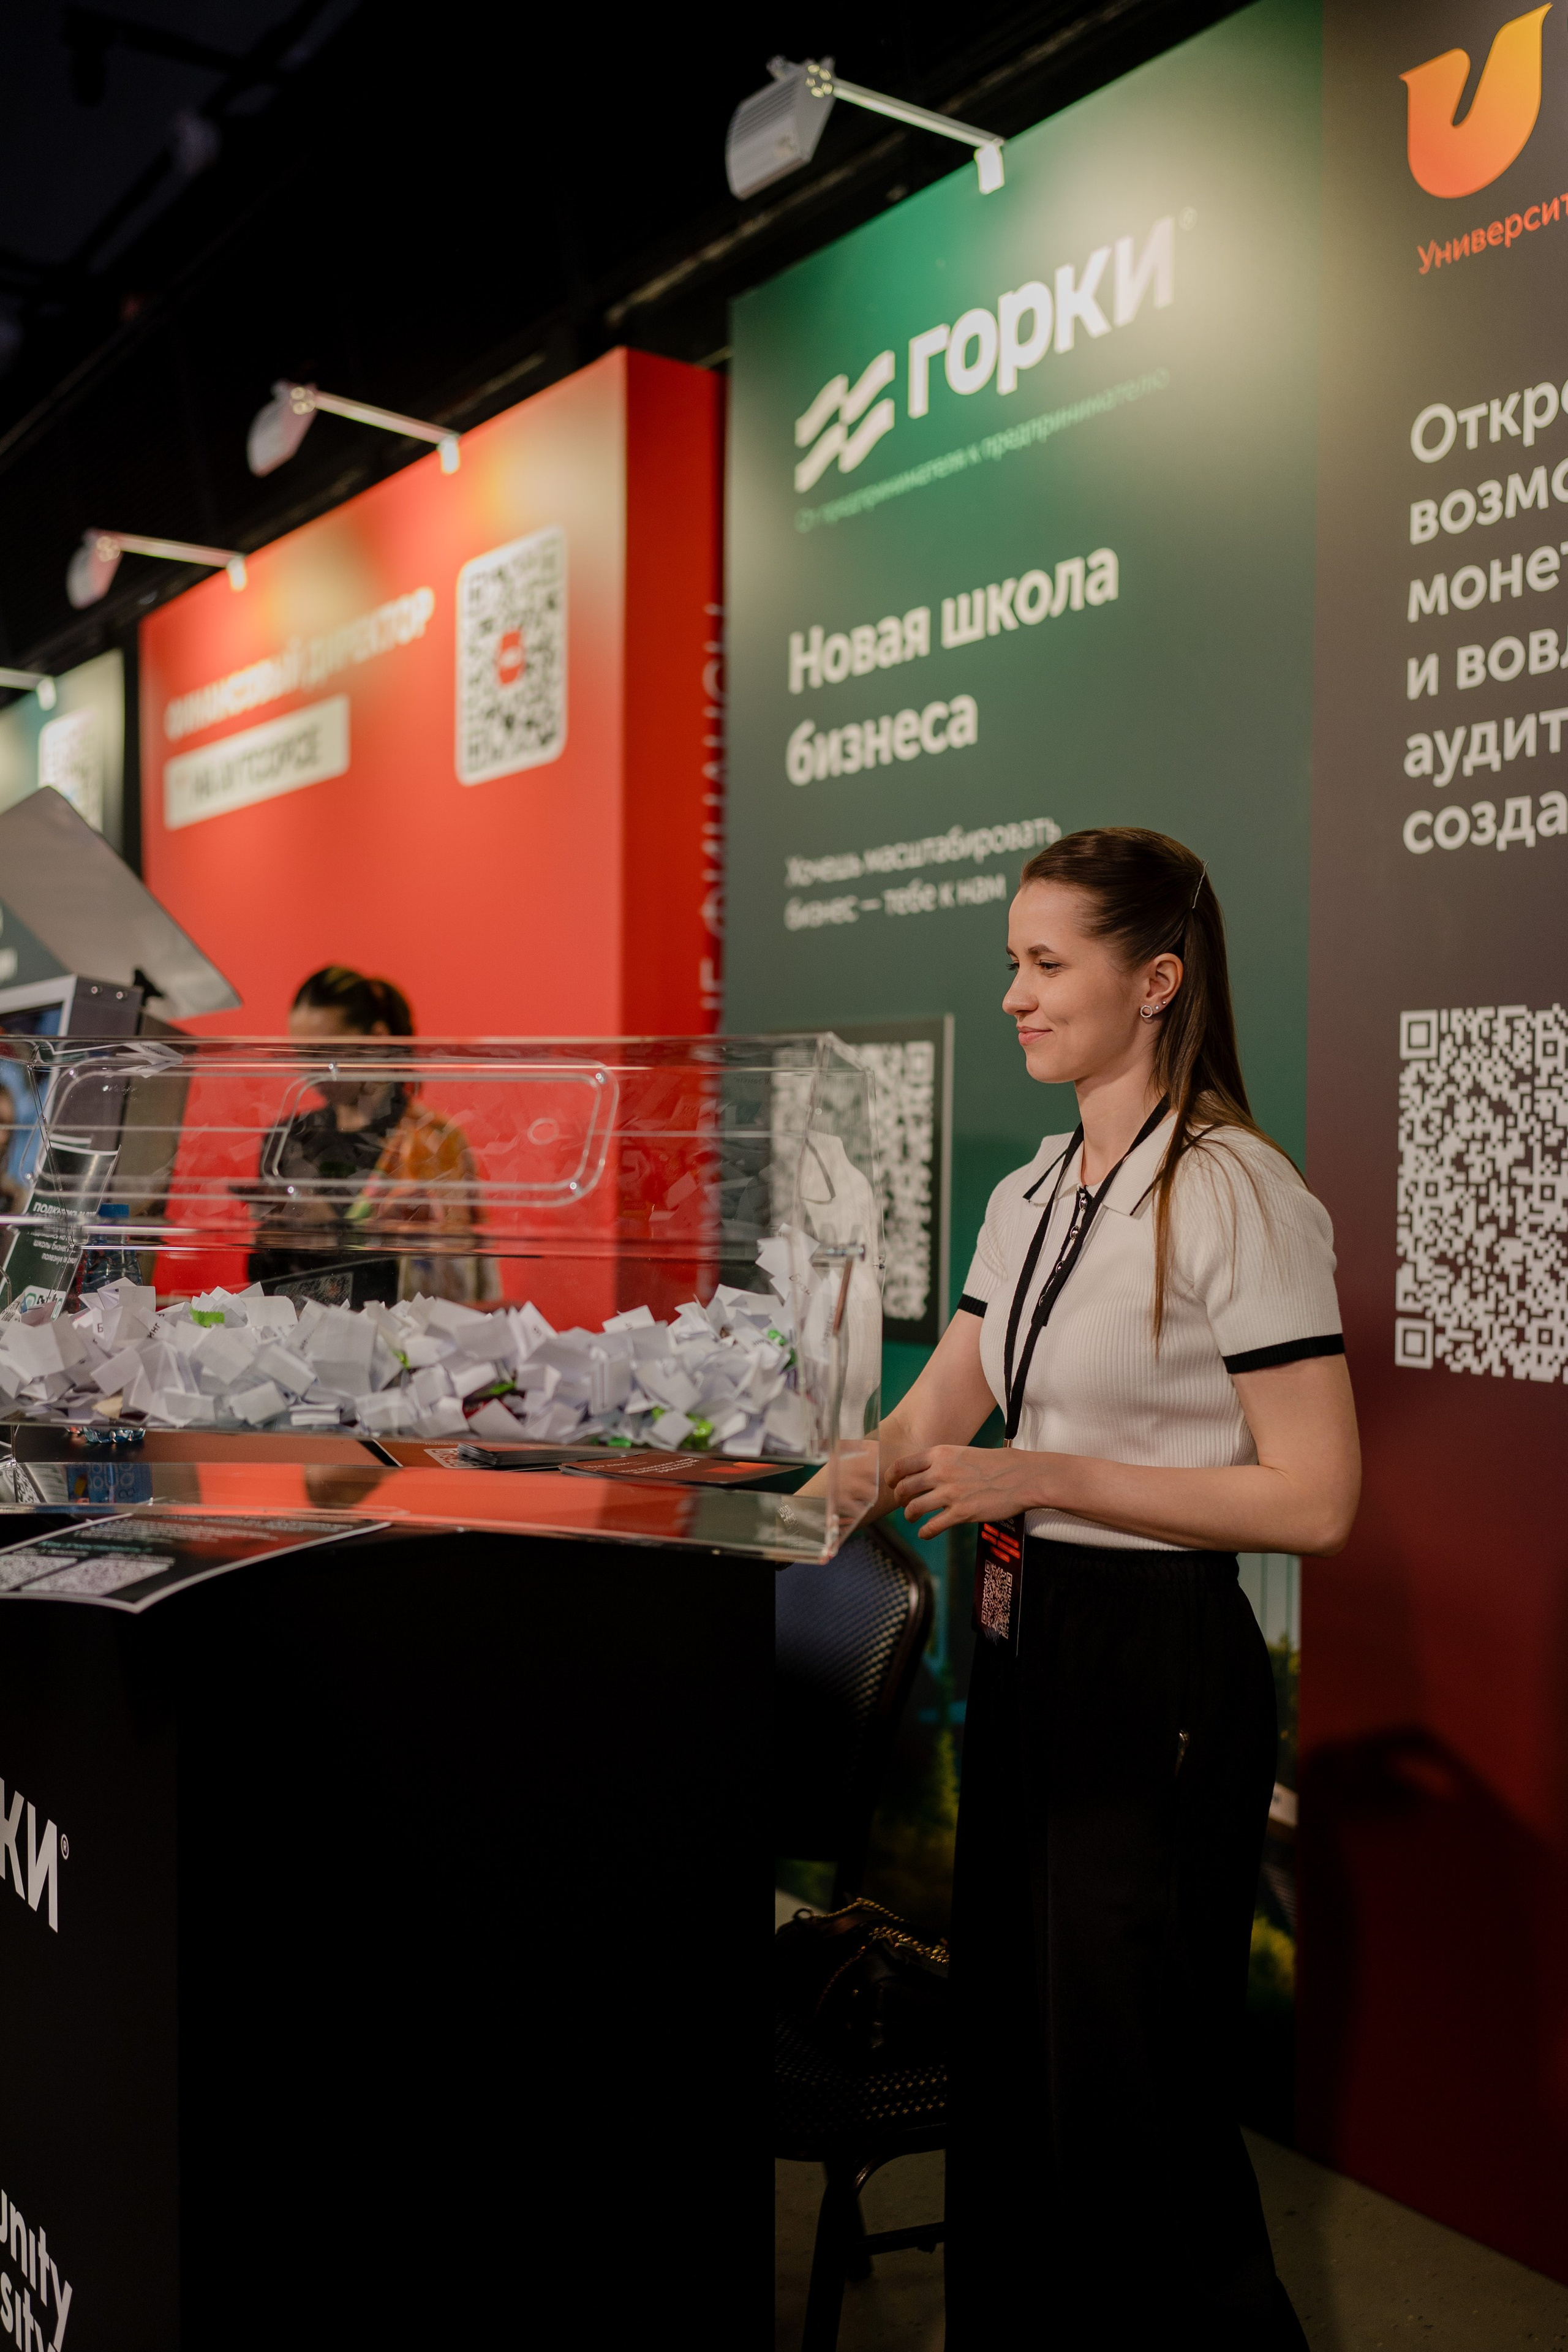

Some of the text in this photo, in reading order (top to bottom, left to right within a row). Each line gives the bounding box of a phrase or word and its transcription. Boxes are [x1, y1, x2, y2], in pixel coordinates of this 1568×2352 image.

[1410, 379, 1568, 464] Откр
[788, 547, 1120, 694] Новая школа
[1408, 541, 1568, 623] моне
[1406, 624, 1568, 700] и вов
[786, 694, 979, 786] бизнеса
[1403, 706, 1568, 788] аудит
[1403, 790, 1568, 854] созда
